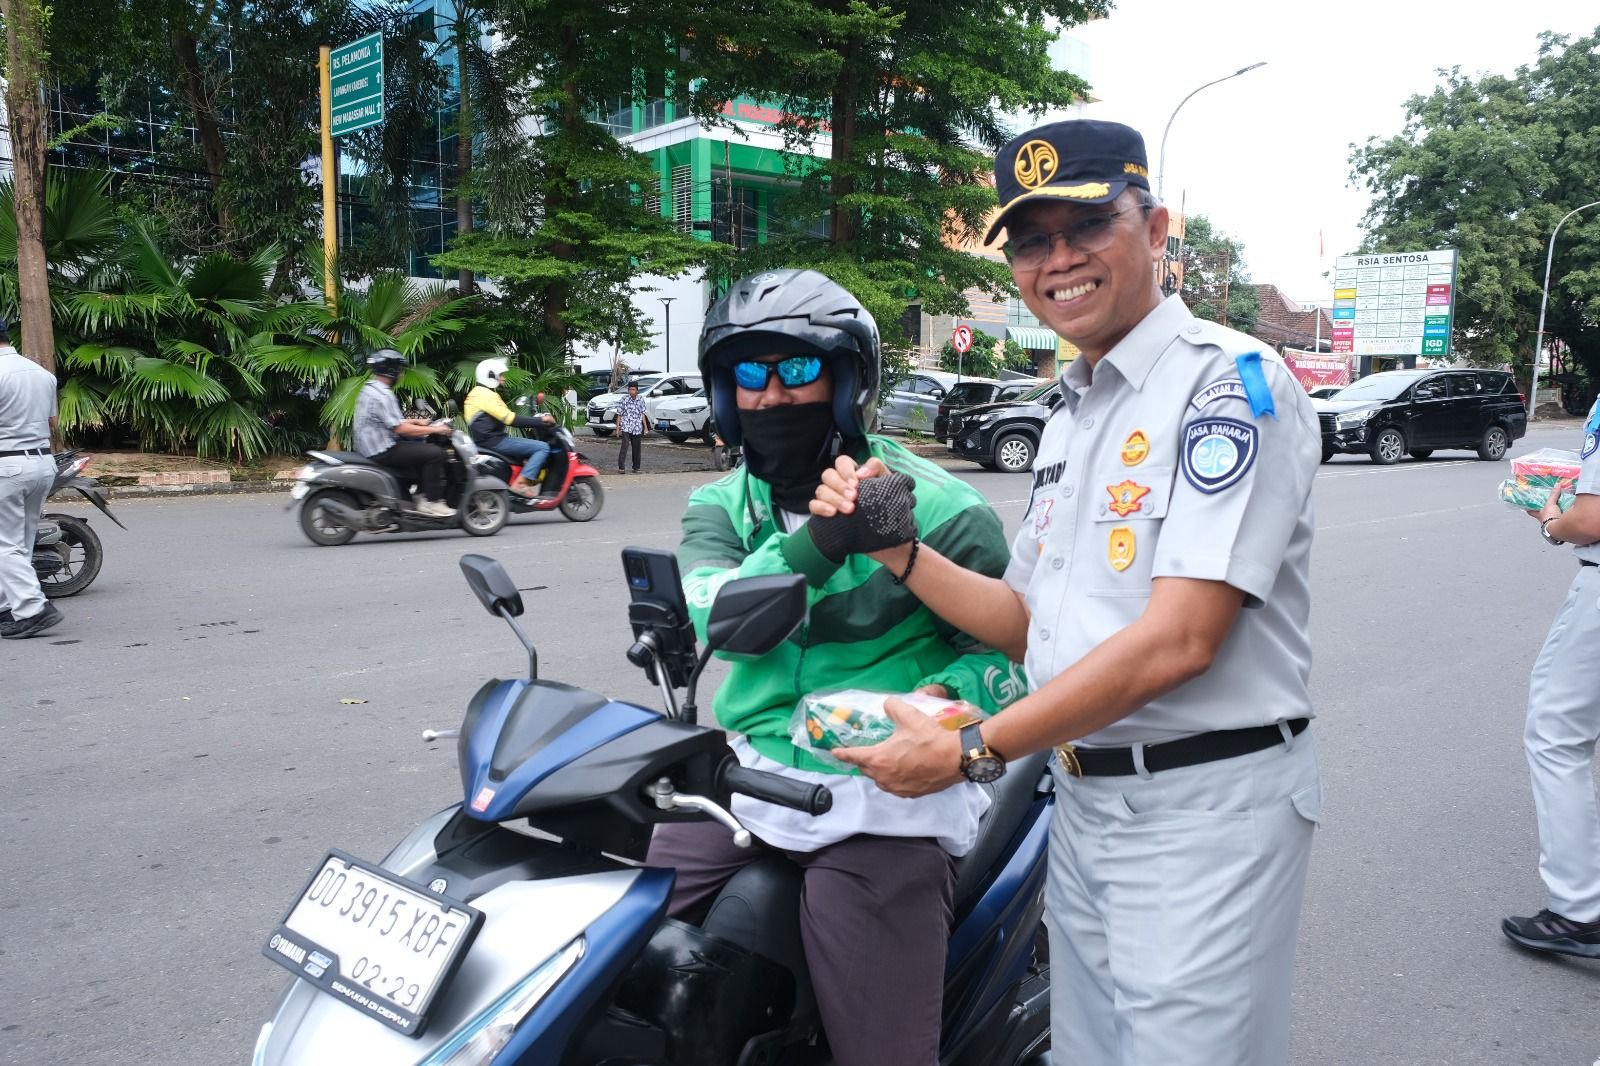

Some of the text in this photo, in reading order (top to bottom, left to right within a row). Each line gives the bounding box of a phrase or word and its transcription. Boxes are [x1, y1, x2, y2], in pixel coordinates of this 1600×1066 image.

[333, 46, 370, 69] RS. PELAMONIA
[365, 104, 375, 117] MALL
[1357, 254, 1429, 267] RSIA SENTOSA
[1425, 339, 1443, 348] IGD
[1189, 424, 1250, 444] JASA RAHARJA
[339, 880, 408, 937] 3915
[398, 907, 457, 959] XBF
[276, 936, 307, 964] YAMAHA
[376, 1006, 411, 1029] DEPAN
